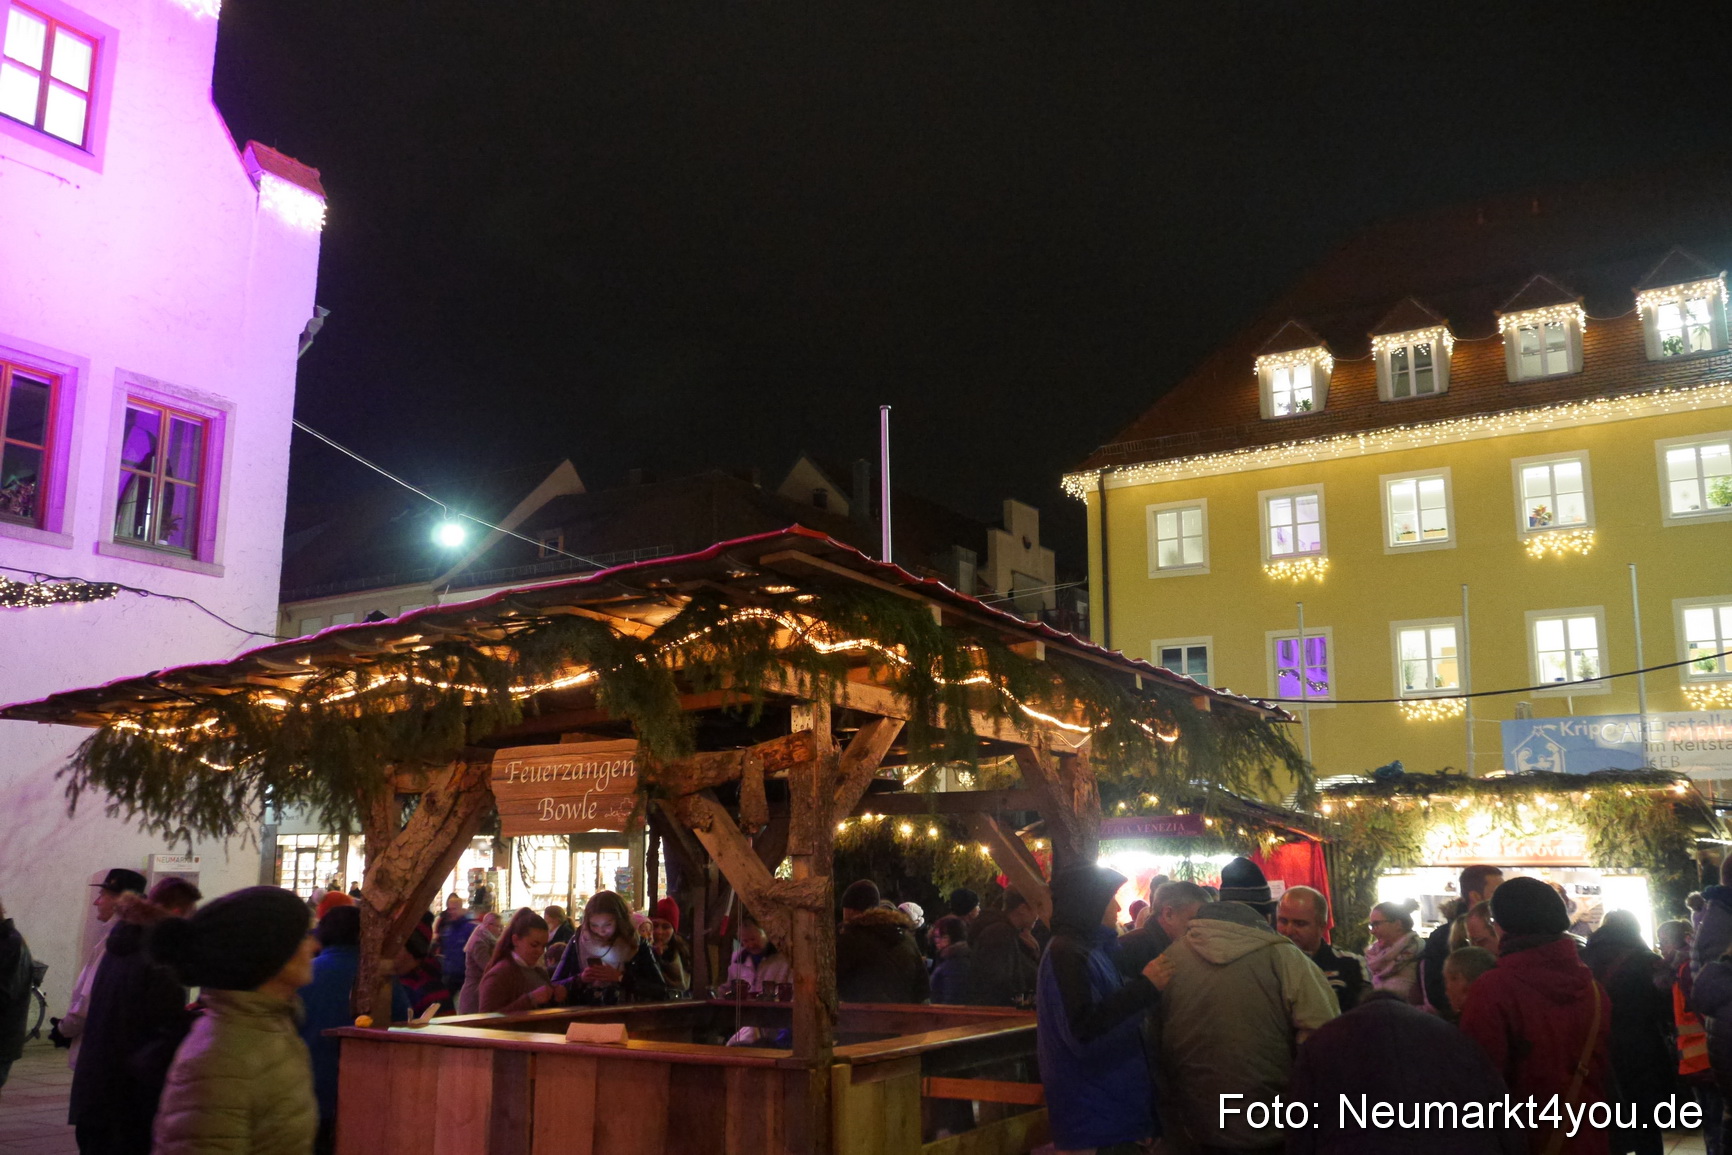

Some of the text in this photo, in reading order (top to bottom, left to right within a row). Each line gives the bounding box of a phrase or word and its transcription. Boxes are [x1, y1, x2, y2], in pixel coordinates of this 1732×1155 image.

[1696, 725, 1732, 741] RAT
[505, 758, 636, 792] Feuerzangen
[538, 789, 597, 821] Bowle
[1136, 822, 1185, 834] VENEZIA
